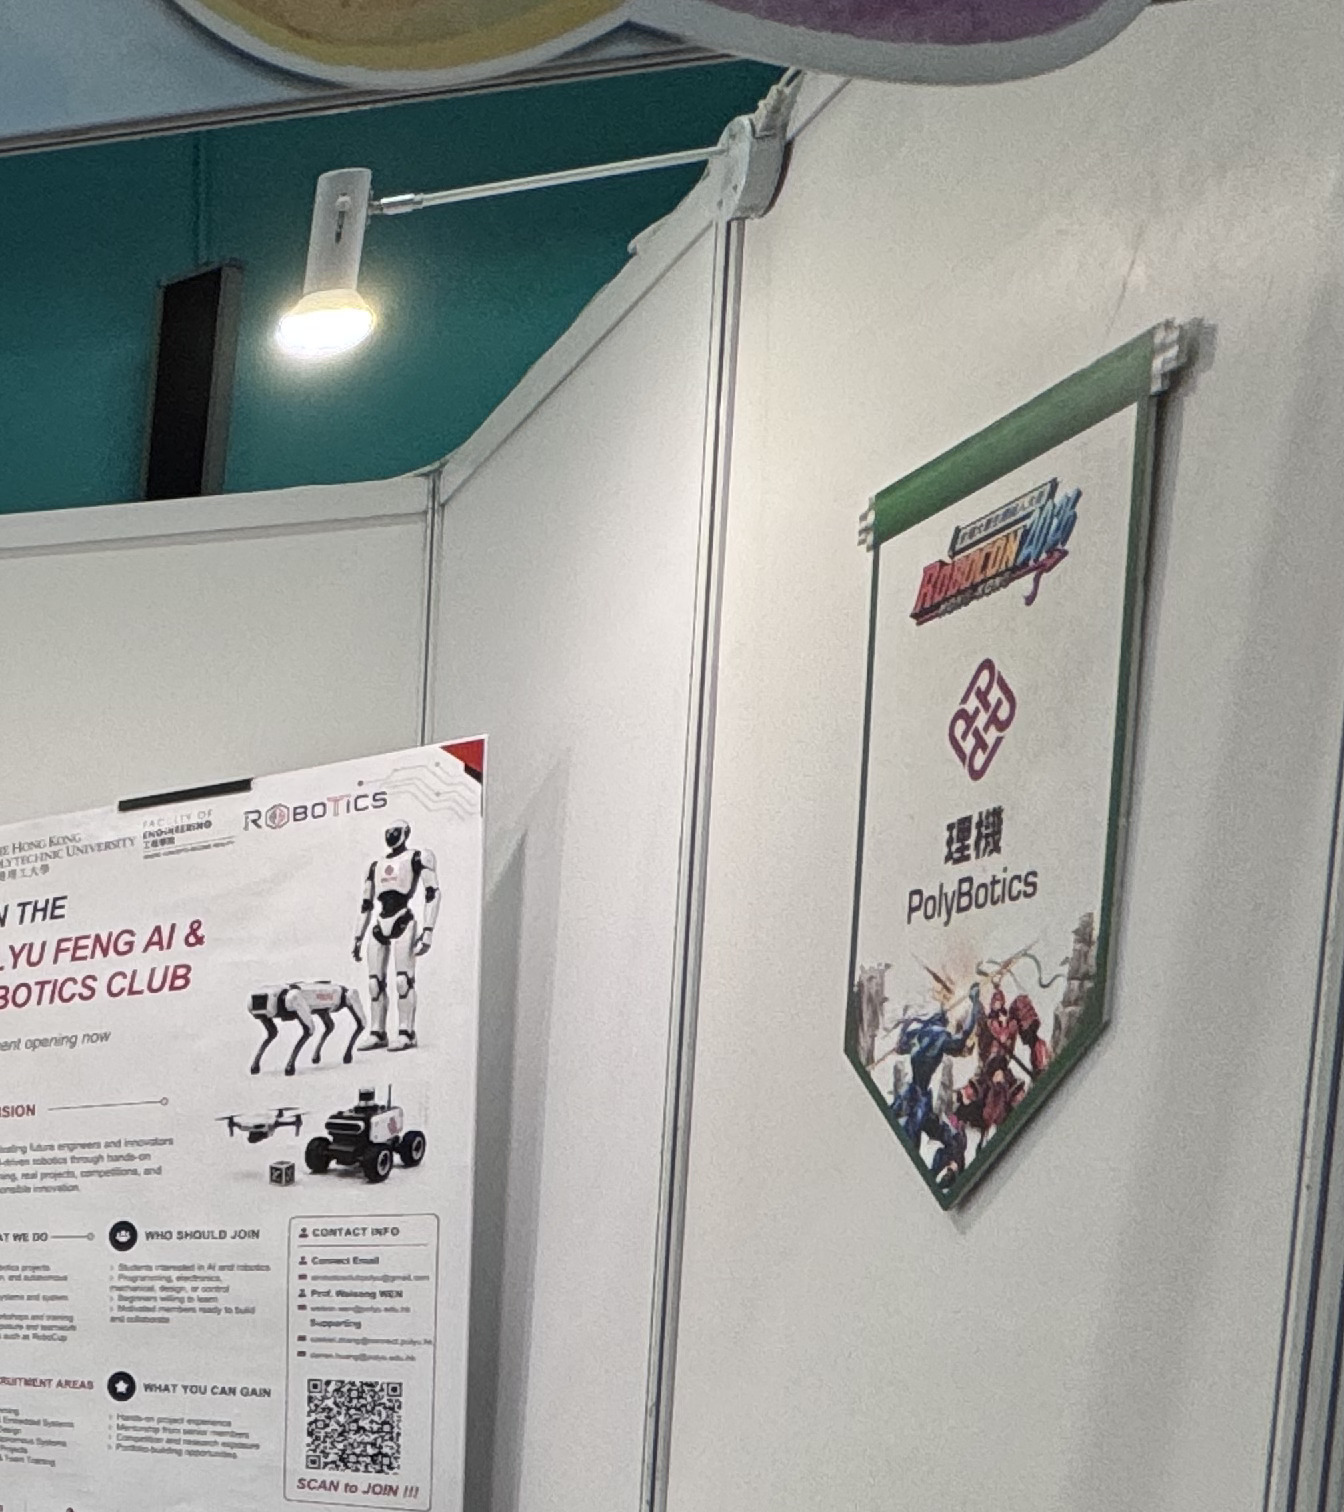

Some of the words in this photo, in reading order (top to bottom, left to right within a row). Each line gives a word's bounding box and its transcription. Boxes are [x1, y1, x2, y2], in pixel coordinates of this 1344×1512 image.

[943, 804, 1005, 866] 理機
[906, 866, 1039, 928] PolyBotics
[16, 895, 68, 925] THE
[52, 928, 136, 965] FENG
[142, 922, 177, 954] AI
[184, 919, 206, 948] &
[106, 964, 193, 998] CLUB
[25, 1033, 78, 1051] opening
[81, 1030, 112, 1044] now
[12, 1232, 29, 1242] WE
[32, 1232, 48, 1242] DO
[145, 1230, 173, 1241] WHO
[176, 1229, 227, 1240] SHOULD
[230, 1229, 260, 1240] JOIN
[312, 1227, 368, 1238] CONTACT
[371, 1227, 400, 1237] INFO
[56, 1379, 94, 1390] AREAS
[143, 1383, 178, 1393] WHAT
[181, 1384, 208, 1395] YOU
[210, 1385, 236, 1396] CAN
[240, 1386, 272, 1397] GAIN
[297, 1477, 340, 1492] SCAN
[344, 1482, 358, 1494] to
[362, 1483, 400, 1498] JOIN
